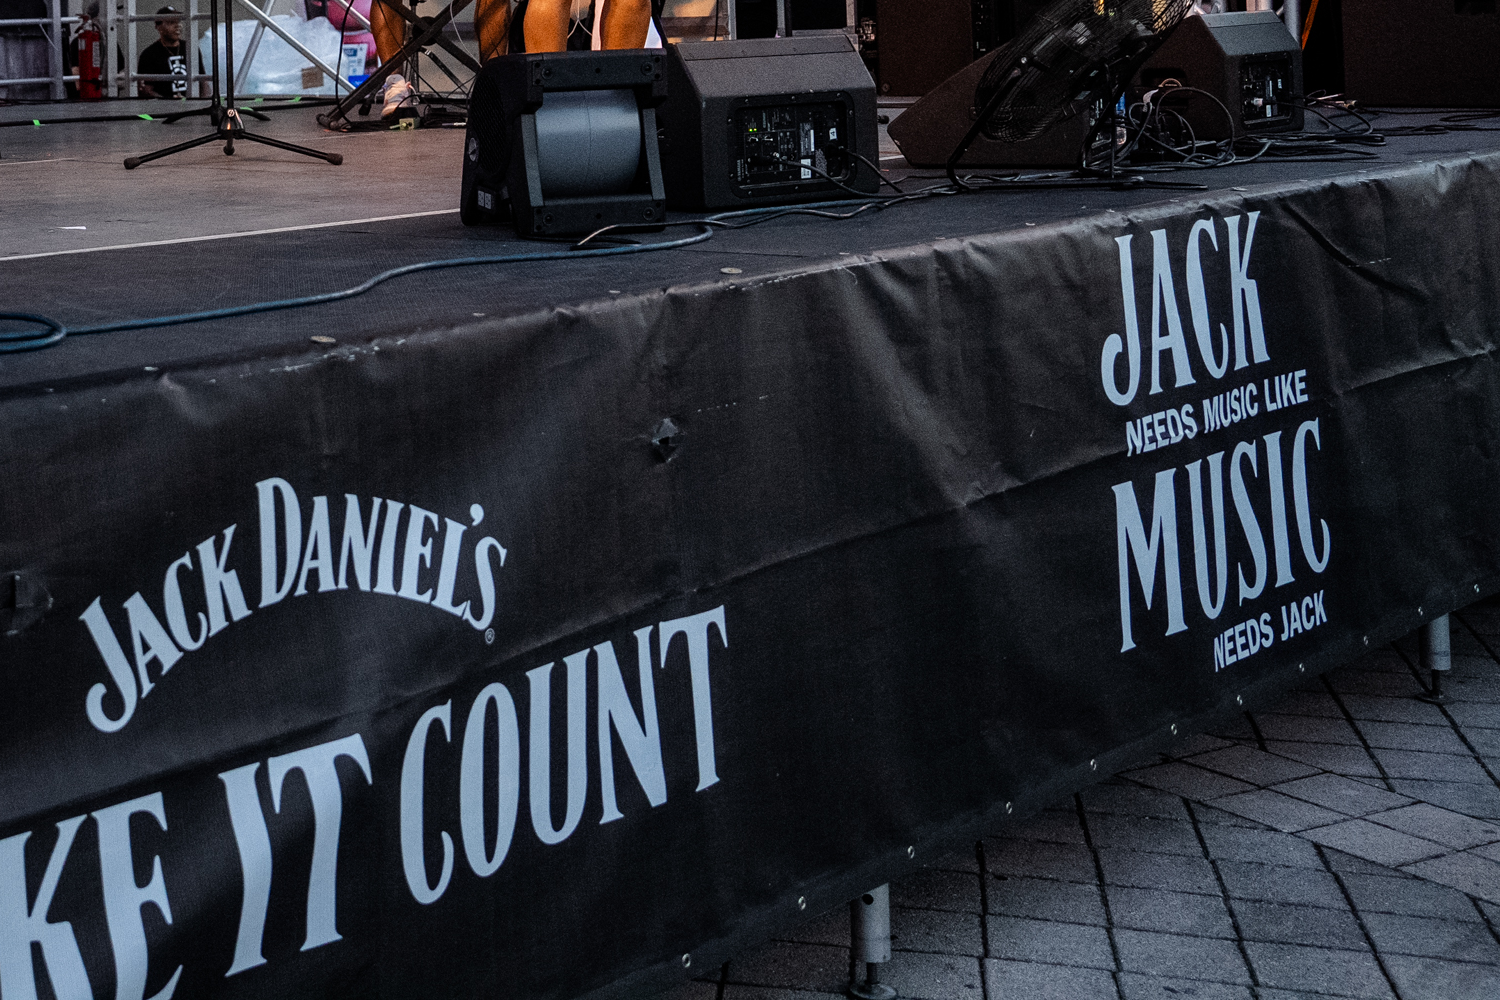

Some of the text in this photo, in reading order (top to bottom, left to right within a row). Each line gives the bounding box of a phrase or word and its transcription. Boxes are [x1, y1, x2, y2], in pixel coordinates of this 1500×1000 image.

[1100, 210, 1271, 406] JACK
[1125, 368, 1309, 457] NEEDS MUSIC LIKE
[78, 476, 507, 733] JACK DANIEL'S
[1111, 417, 1331, 653] MUSIC
[1213, 589, 1328, 672] NEEDS JACK
[218, 733, 373, 977] IT
[400, 604, 728, 905] COUNT
